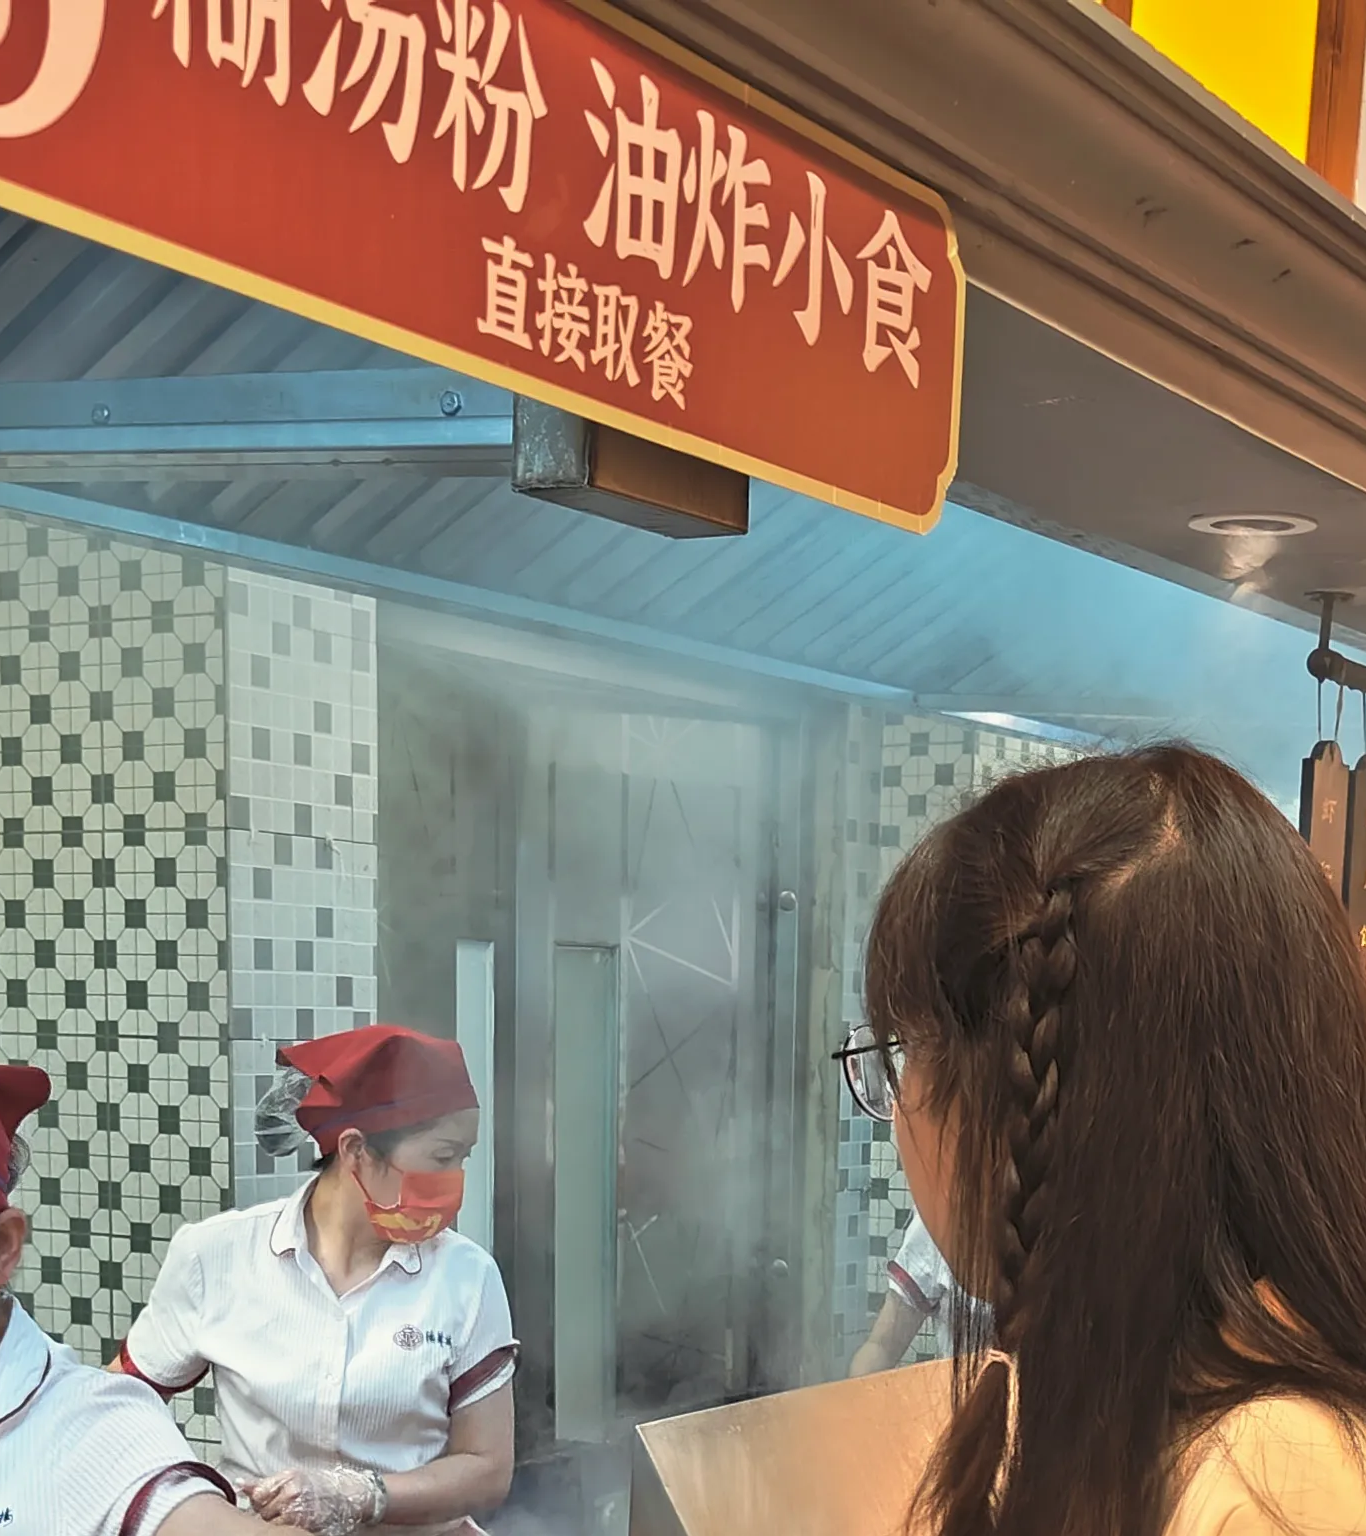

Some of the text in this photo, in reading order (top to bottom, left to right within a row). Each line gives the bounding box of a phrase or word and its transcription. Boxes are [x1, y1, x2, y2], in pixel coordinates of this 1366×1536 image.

[476, 237, 693, 411] 直接取餐
[583, 57, 933, 389] 油炸小食
